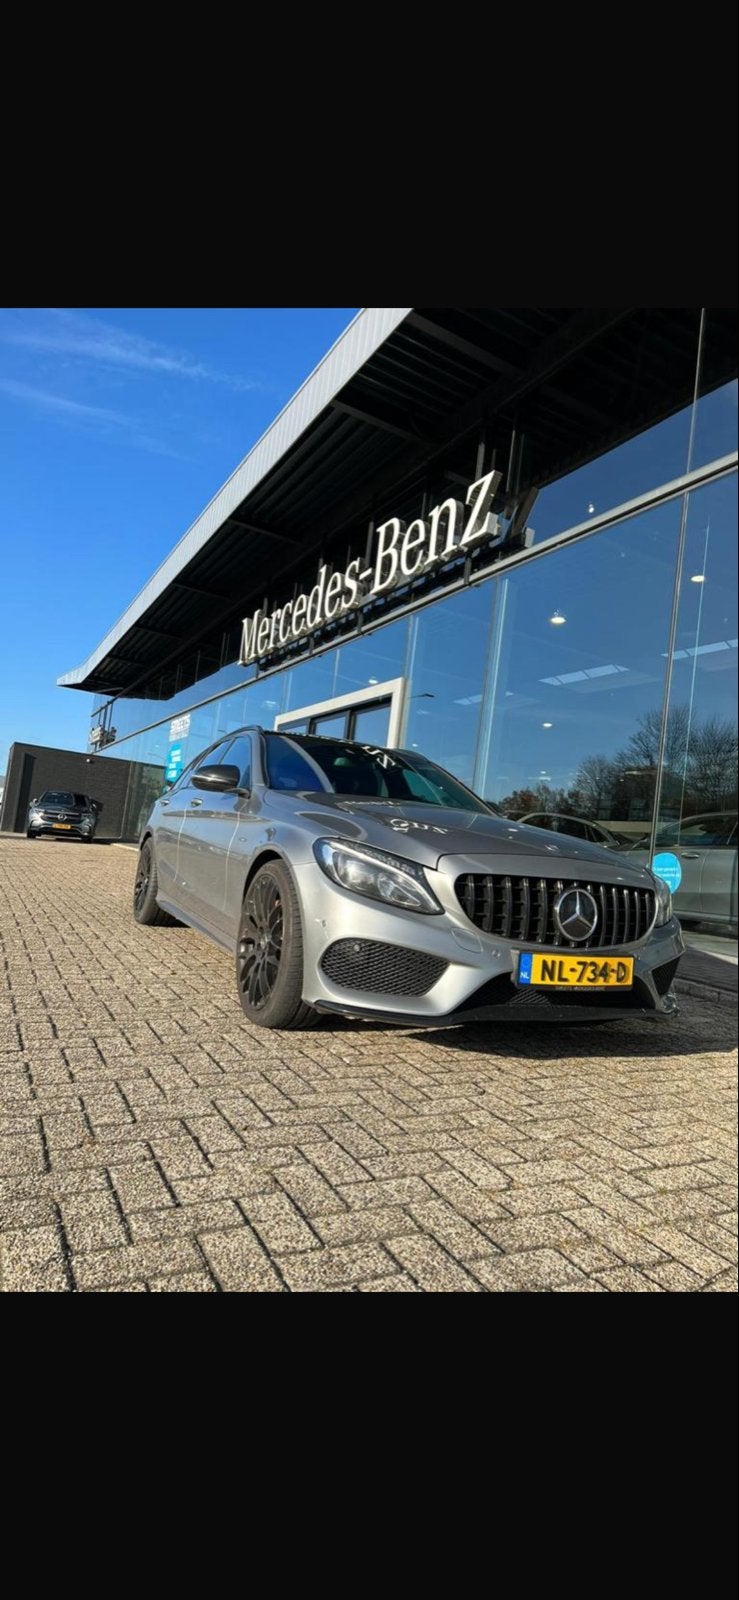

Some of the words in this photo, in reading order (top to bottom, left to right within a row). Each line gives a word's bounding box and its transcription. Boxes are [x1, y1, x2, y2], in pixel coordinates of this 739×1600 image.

[237, 469, 501, 665] Mercedes-Benz
[520, 971, 530, 980] NL
[541, 959, 628, 983] NL-734-D
